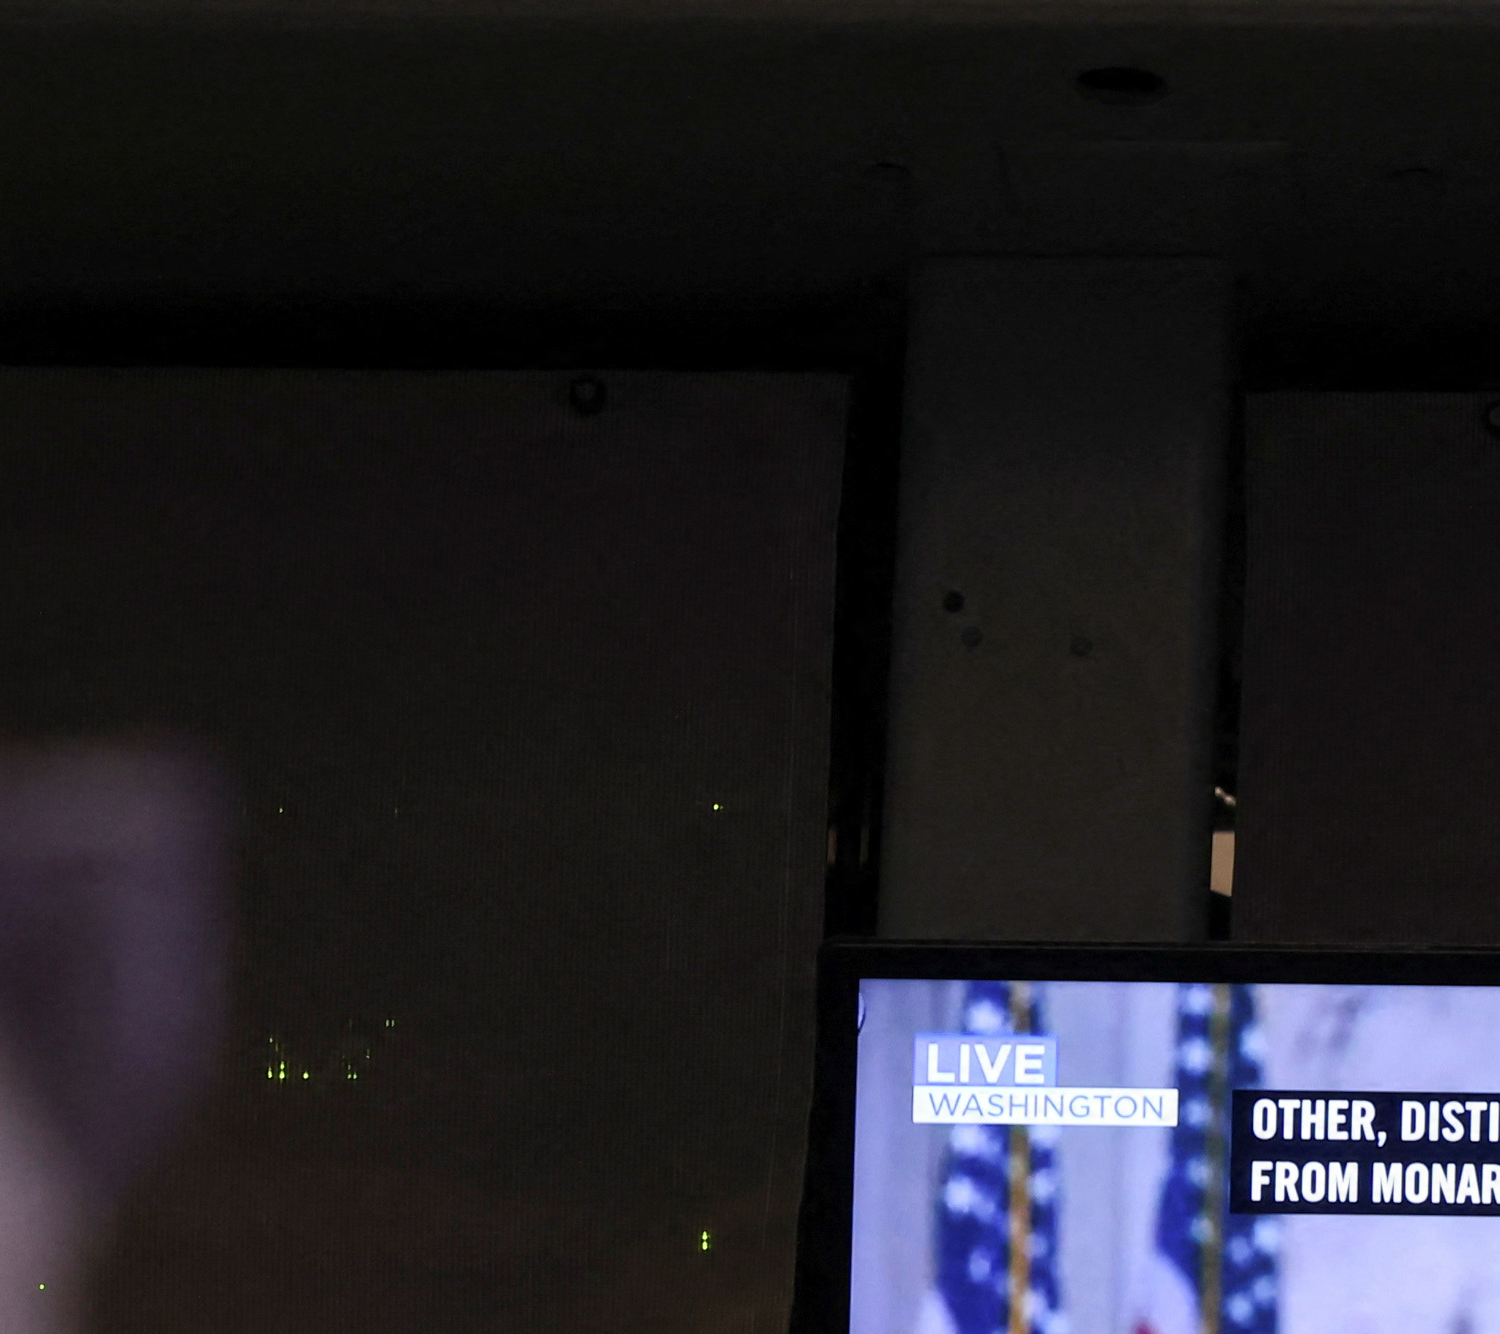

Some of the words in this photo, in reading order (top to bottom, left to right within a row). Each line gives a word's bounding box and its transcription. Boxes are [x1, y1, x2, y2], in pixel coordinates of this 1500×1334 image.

[928, 1043, 1045, 1084] LIVE
[929, 1094, 1164, 1119] WASHINGTON
[1252, 1100, 1388, 1146] OTHER,
[1251, 1161, 1359, 1203] FROM
